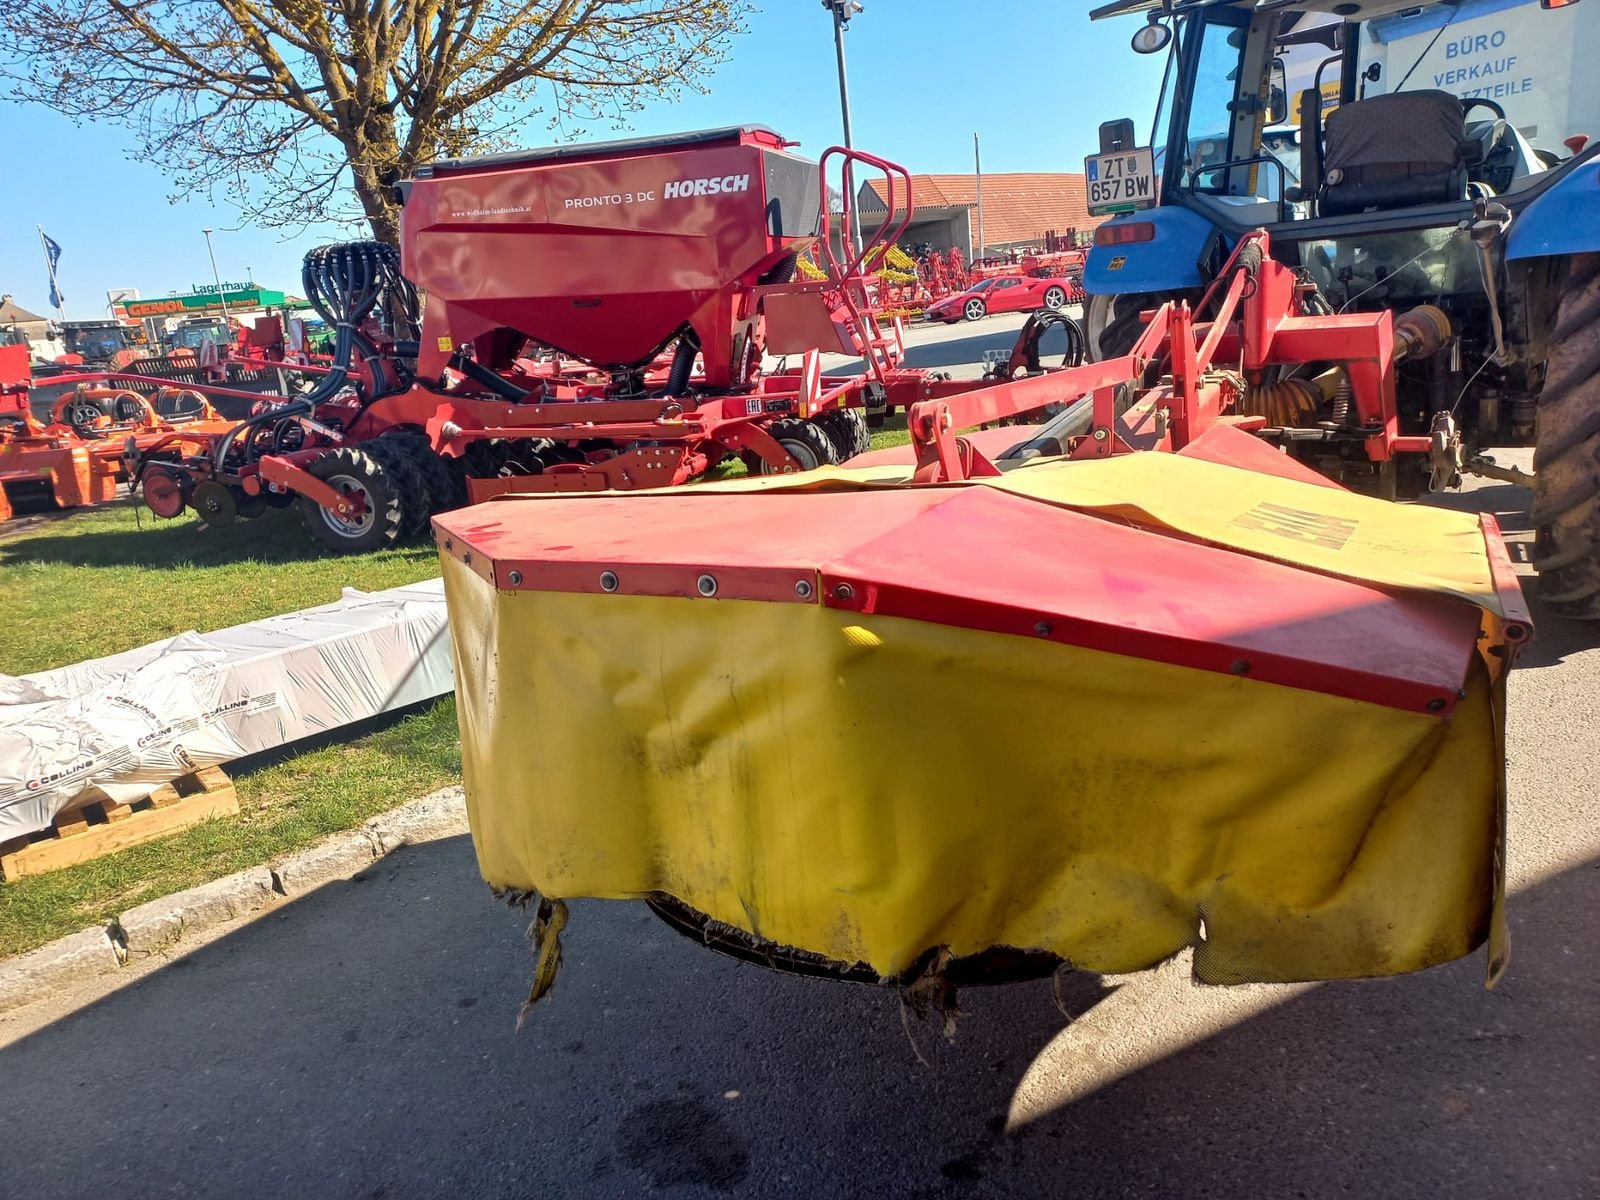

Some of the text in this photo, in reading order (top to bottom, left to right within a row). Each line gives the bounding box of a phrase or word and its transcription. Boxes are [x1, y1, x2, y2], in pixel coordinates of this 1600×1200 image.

[1445, 30, 1506, 60] BÜRO
[1433, 56, 1517, 88] VERKAUF
[1460, 78, 1533, 100] TZTEILE
[1104, 157, 1124, 179] ZT
[663, 173, 750, 200] HORSCH
[1091, 174, 1149, 202] 657 BW
[564, 190, 656, 209] PRONTO 3 DC
[192, 281, 255, 294] Lagerhaus
